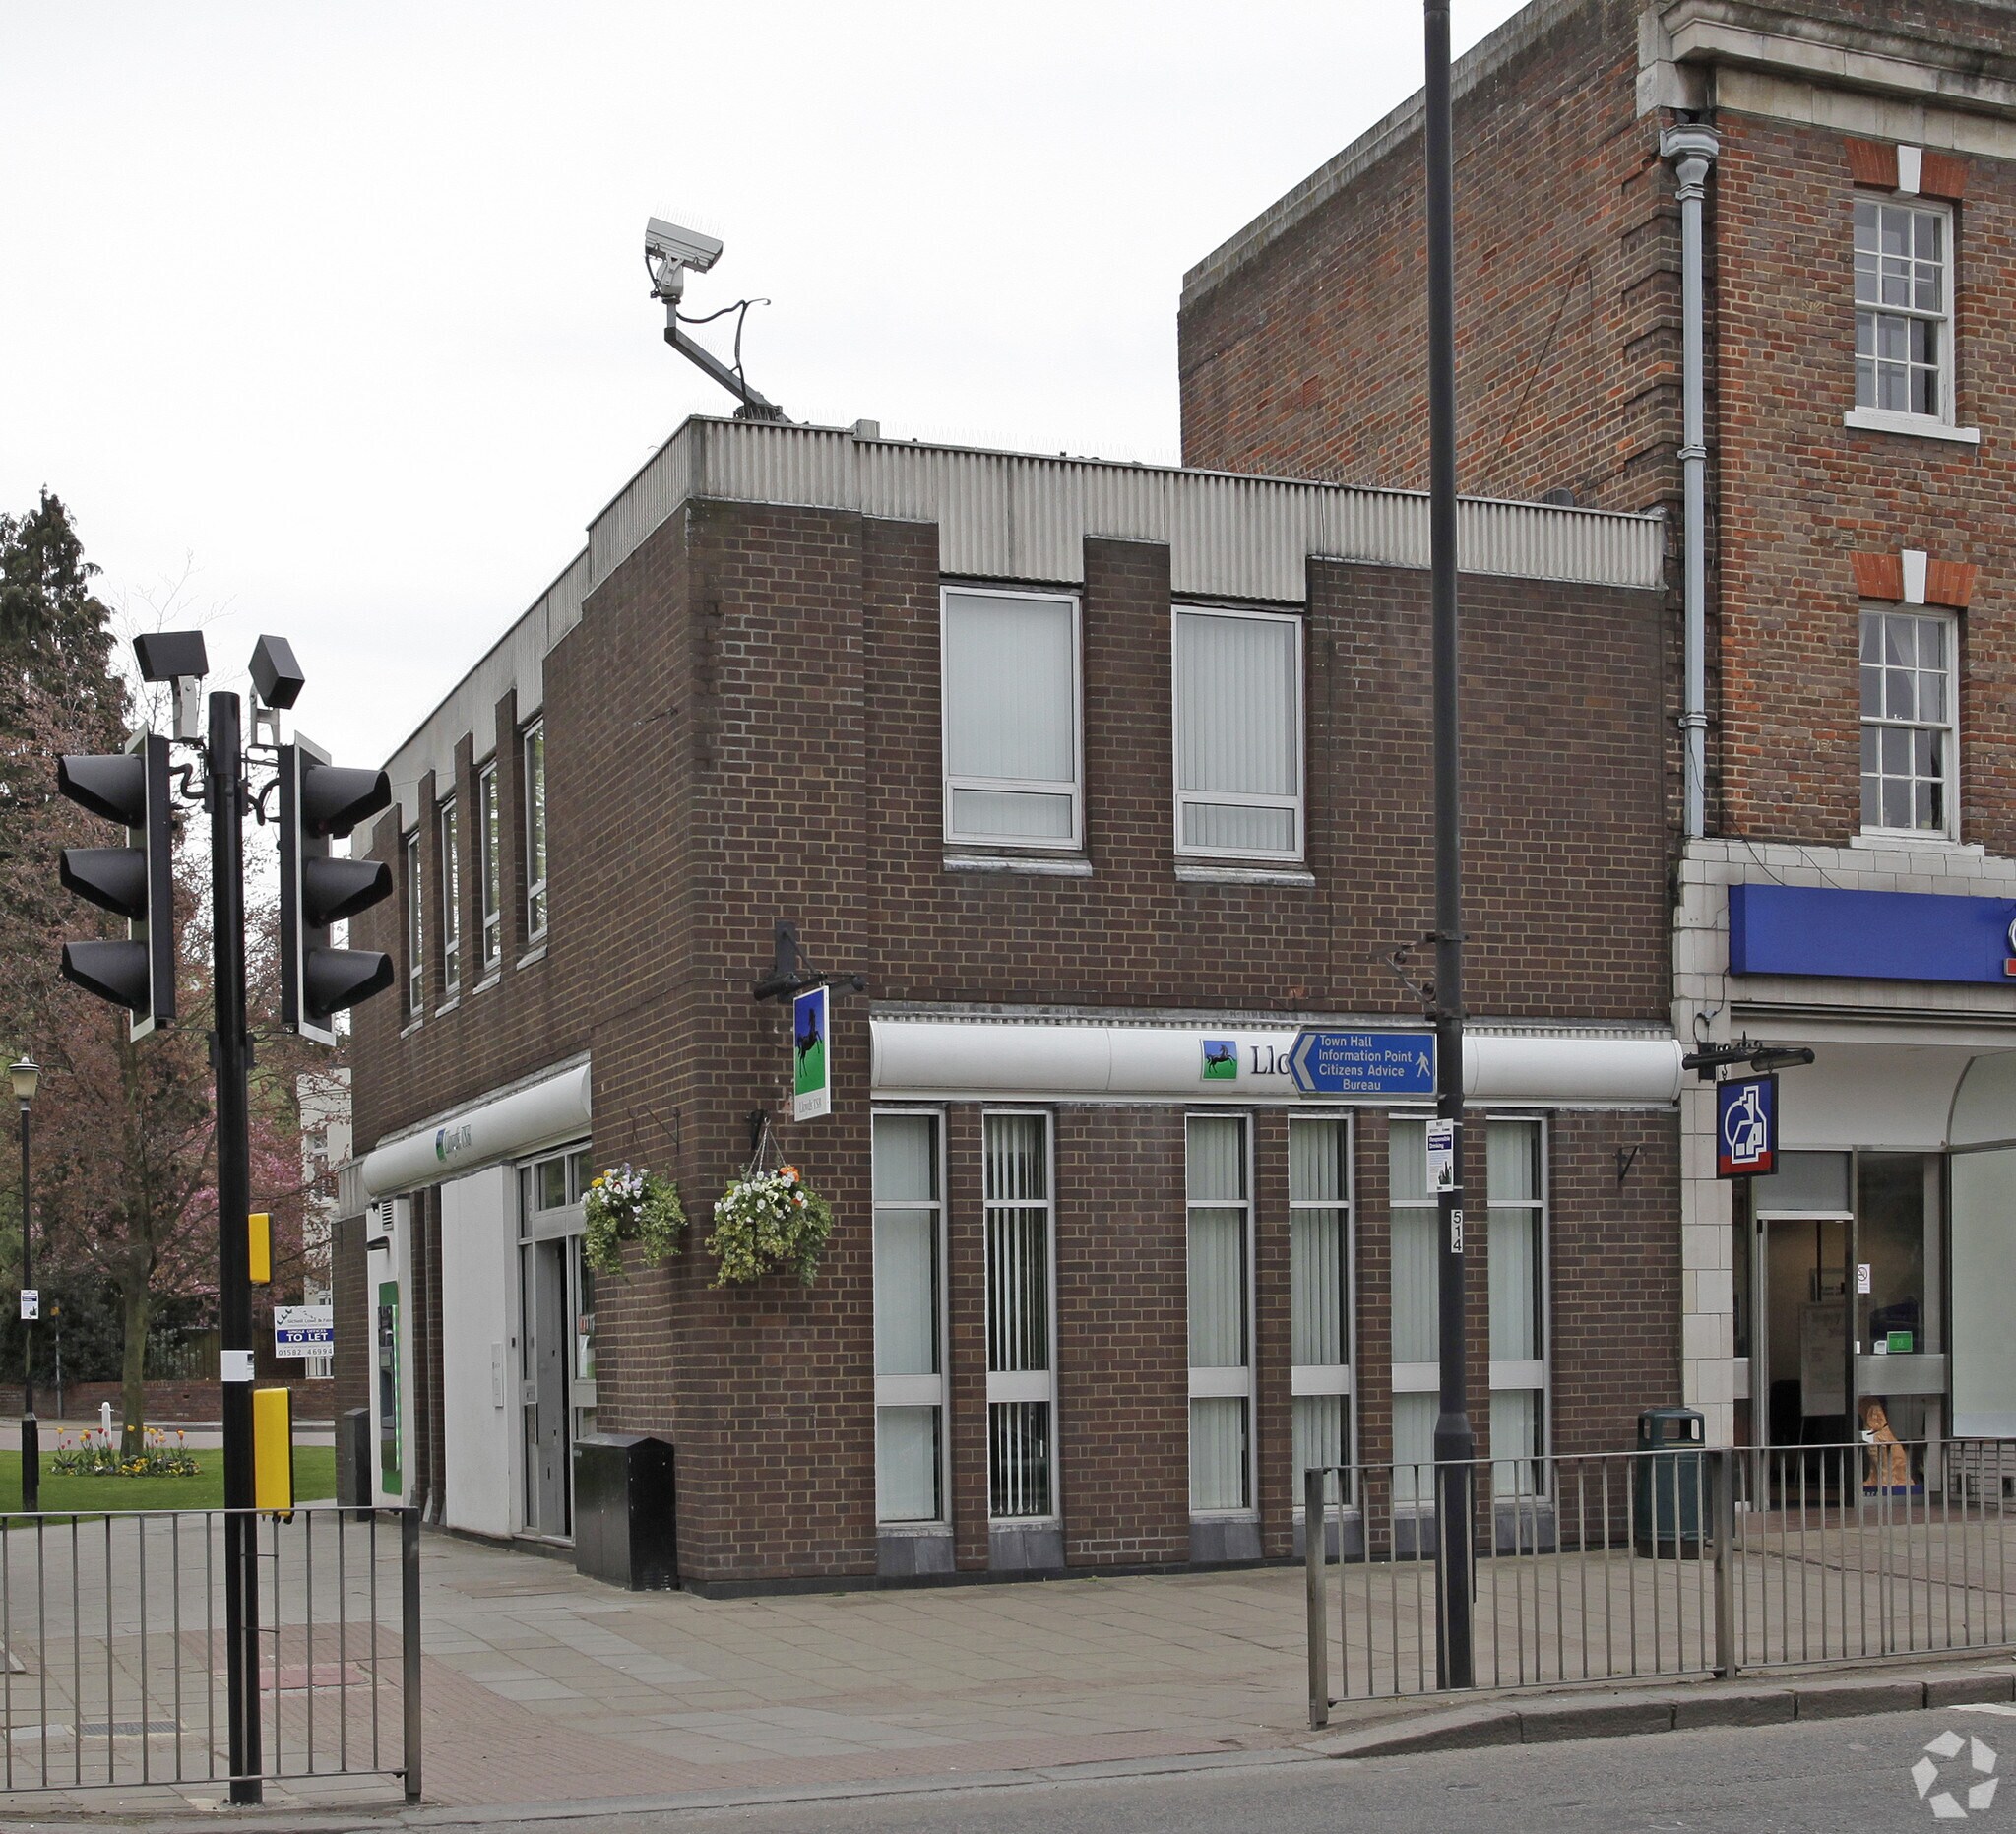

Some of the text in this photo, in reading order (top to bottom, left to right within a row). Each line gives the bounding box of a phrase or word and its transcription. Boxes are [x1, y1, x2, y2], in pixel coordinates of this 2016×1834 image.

[1319, 1035, 1372, 1047] Town Hall
[1319, 1049, 1412, 1062] Information Point
[1319, 1064, 1405, 1076] Citizens Advice
[1343, 1078, 1381, 1090] Bureau
[286, 1333, 303, 1342] TO
